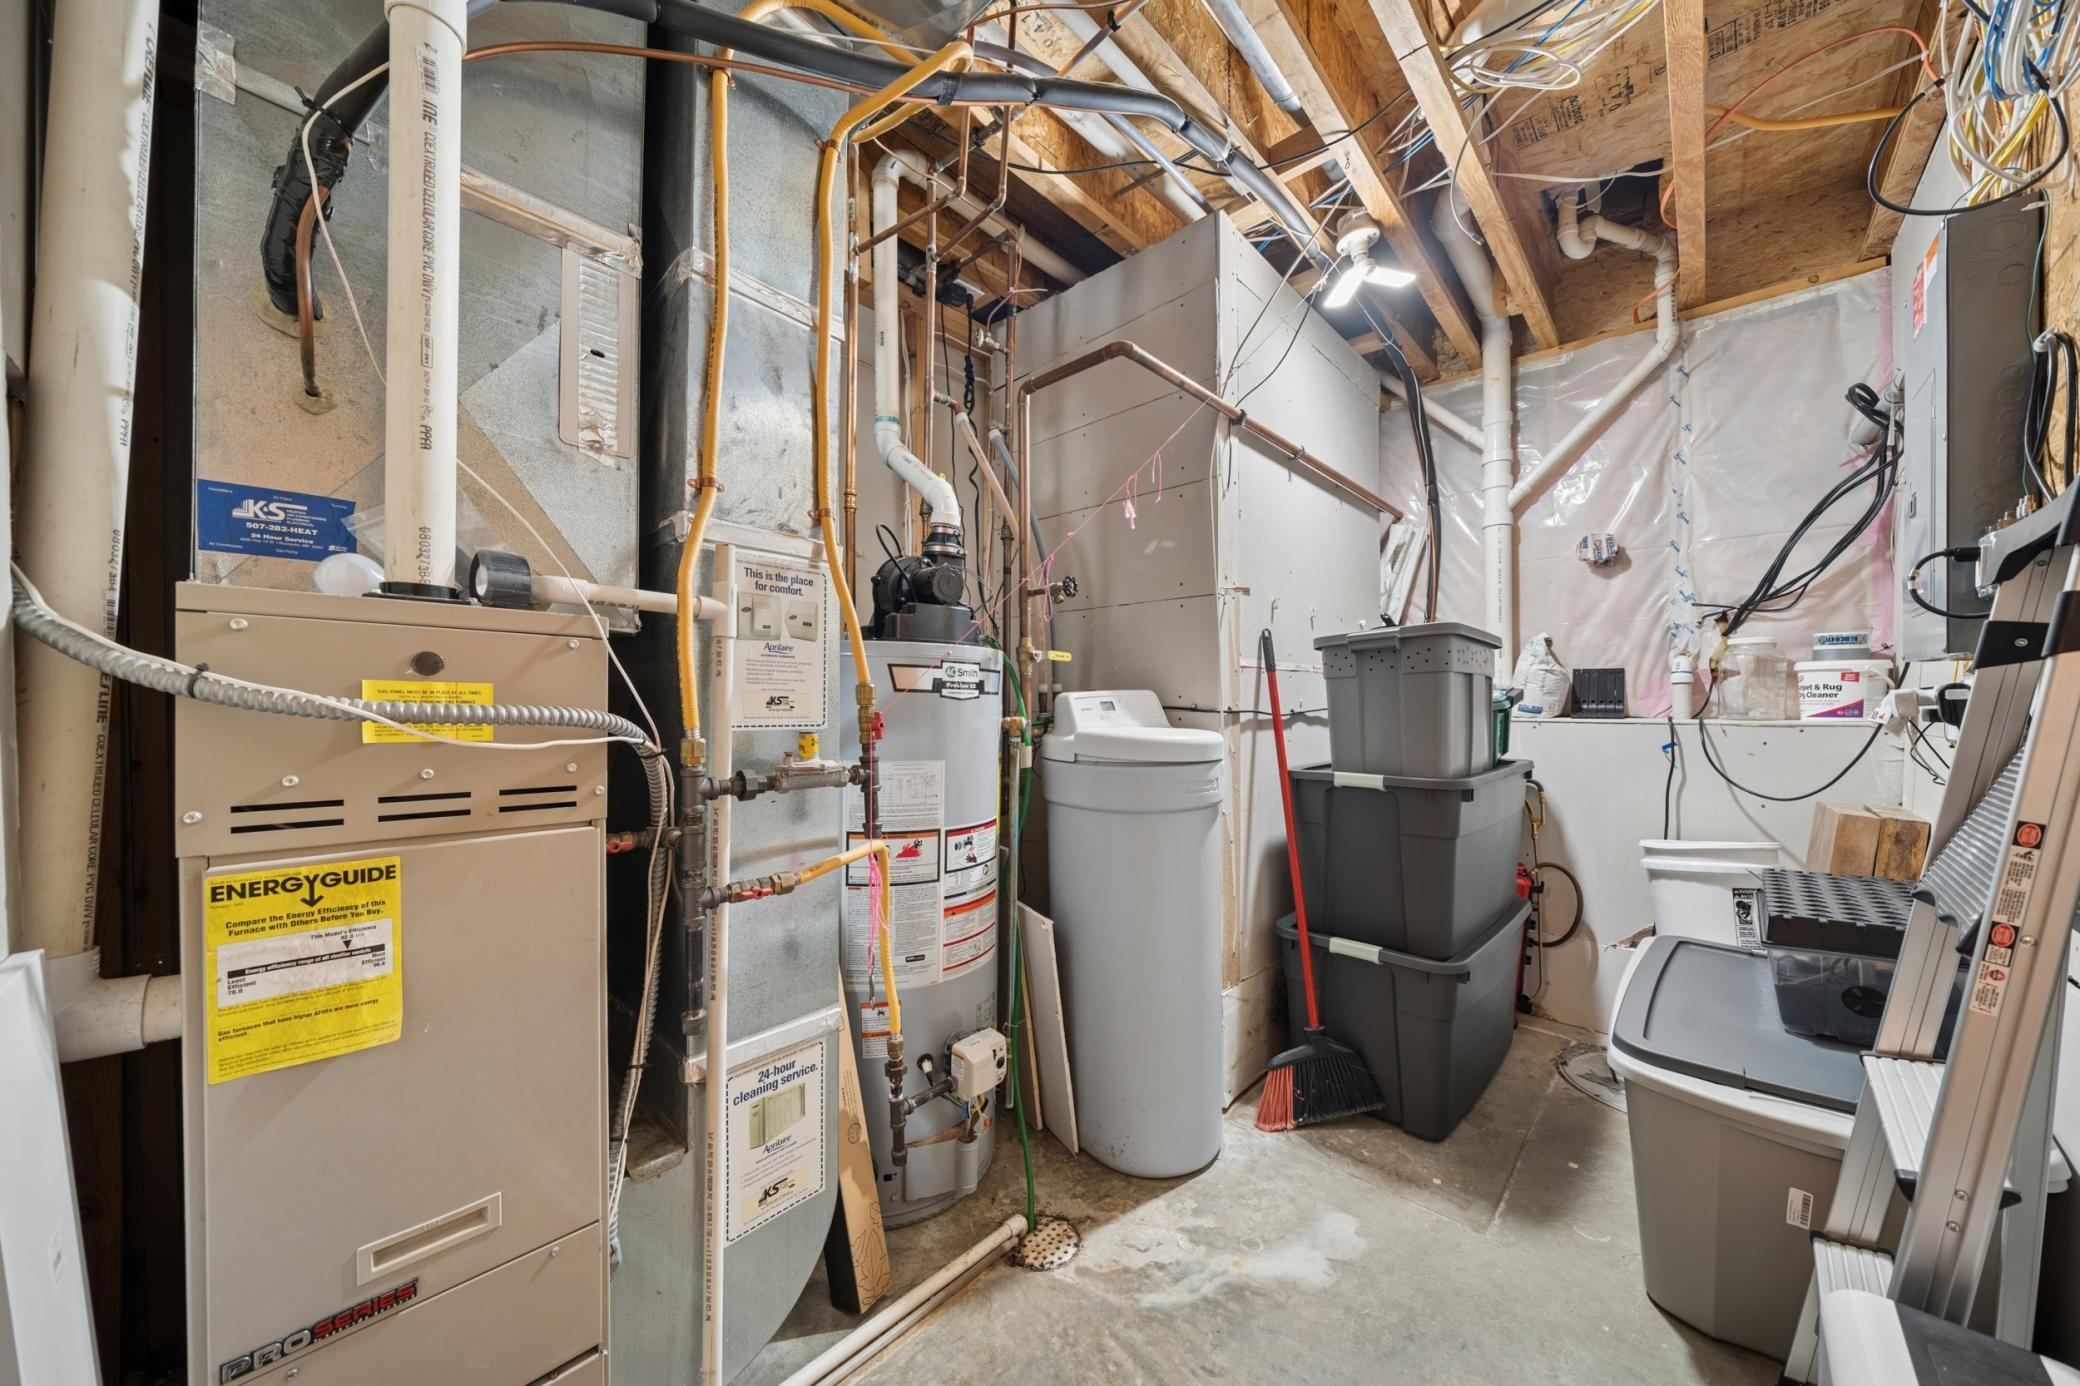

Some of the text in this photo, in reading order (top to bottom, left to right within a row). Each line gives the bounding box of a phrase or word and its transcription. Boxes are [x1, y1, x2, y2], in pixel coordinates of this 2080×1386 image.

[423, 231, 436, 253] CORE
[423, 254, 436, 272] PVC
[420, 424, 432, 450] PPFA
[246, 522, 319, 536] 507-282-HEAT
[285, 535, 314, 544] Service
[744, 567, 763, 580] This
[766, 570, 774, 581] is
[775, 573, 789, 583] the
[790, 575, 814, 587] place
[755, 580, 804, 596] for comfort.
[763, 642, 794, 653] Aprilaire
[957, 668, 978, 678] Smith
[1806, 691, 1839, 699] Cleaner
[1822, 683, 1843, 692] Rug
[88, 798, 100, 844] CELLULAR
[87, 846, 98, 872] CORE
[85, 874, 95, 894] PVC
[82, 896, 94, 919] DWV
[226, 917, 267, 929] Compare
[269, 914, 285, 923] the
[286, 910, 315, 921] Energy
[317, 903, 359, 915] Efficiency
[370, 899, 386, 908] this
[228, 908, 384, 937] Furnace with Others Before You Buy.
[324, 929, 348, 938] Model's
[348, 924, 377, 934] Efficiency
[244, 967, 266, 976] Energy
[267, 961, 297, 972] efficiency
[299, 957, 314, 966] range
[331, 951, 350, 960] similar
[351, 948, 372, 957] models
[361, 956, 386, 965] Efficient
[227, 977, 246, 985] Least
[227, 981, 256, 991] Efficient
[233, 1023, 261, 1034] furnaces
[278, 1016, 292, 1024] have
[294, 1013, 313, 1022] higher
[360, 999, 379, 1008] energy
[218, 1032, 250, 1042] efficient.
[758, 1060, 797, 1083] 24-hour
[733, 1063, 818, 1106] cleaning service.
[762, 1135, 792, 1154] Aprilaire
